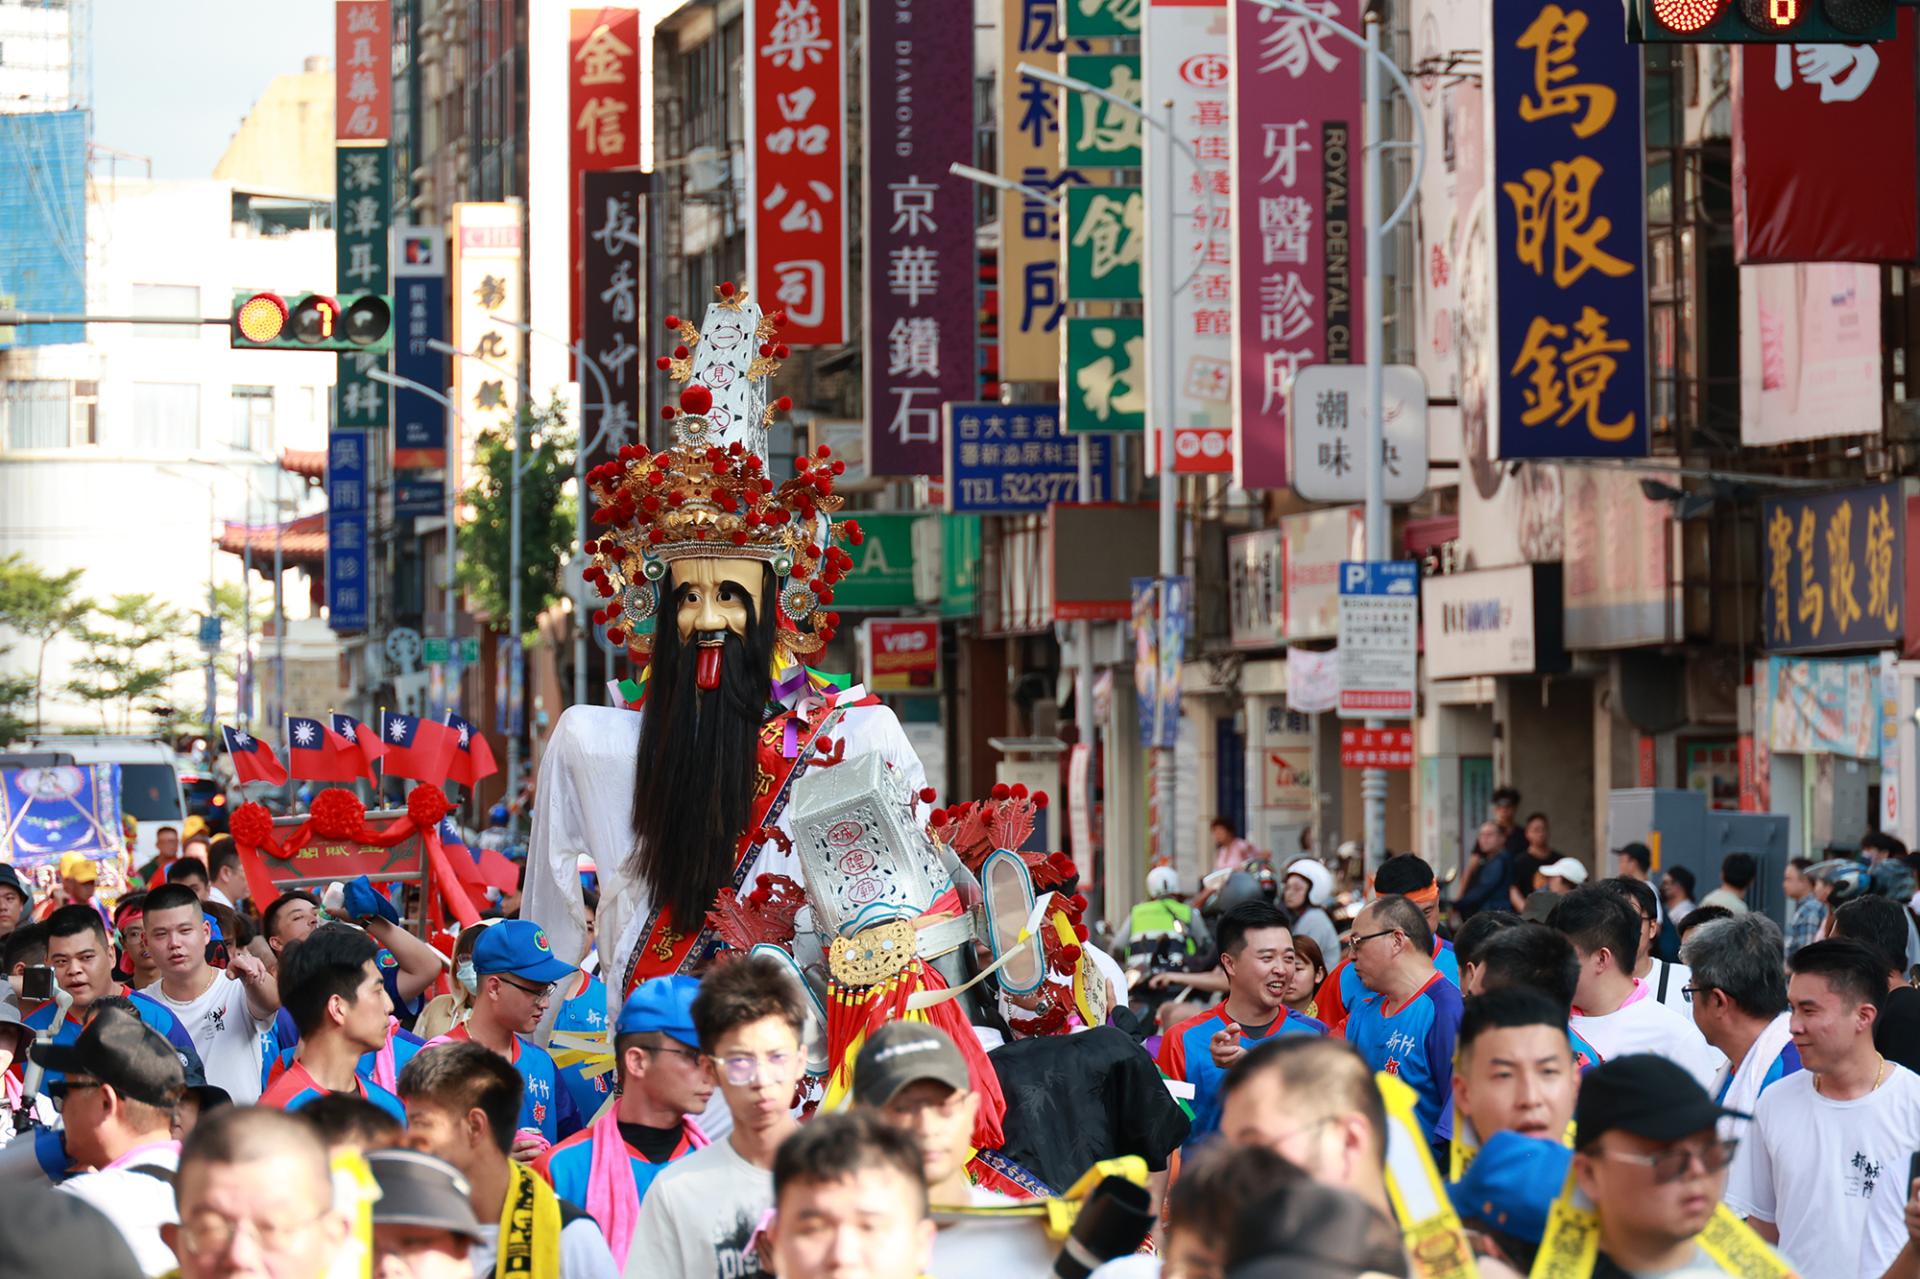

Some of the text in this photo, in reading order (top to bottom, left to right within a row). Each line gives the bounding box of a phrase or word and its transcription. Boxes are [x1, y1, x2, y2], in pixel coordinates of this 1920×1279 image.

[574, 23, 633, 156] 金信
[896, 41, 912, 157] DIAMOND
[1324, 128, 1348, 212] ROYAL
[1504, 4, 1637, 441] 島眼鏡
[887, 175, 941, 445] 京華鑽石
[1326, 220, 1350, 318] DENTAL
[959, 472, 1103, 504] TEL 523771
[1768, 494, 1899, 643] 寶島眼鏡
[830, 826, 876, 900] 城隍廟
